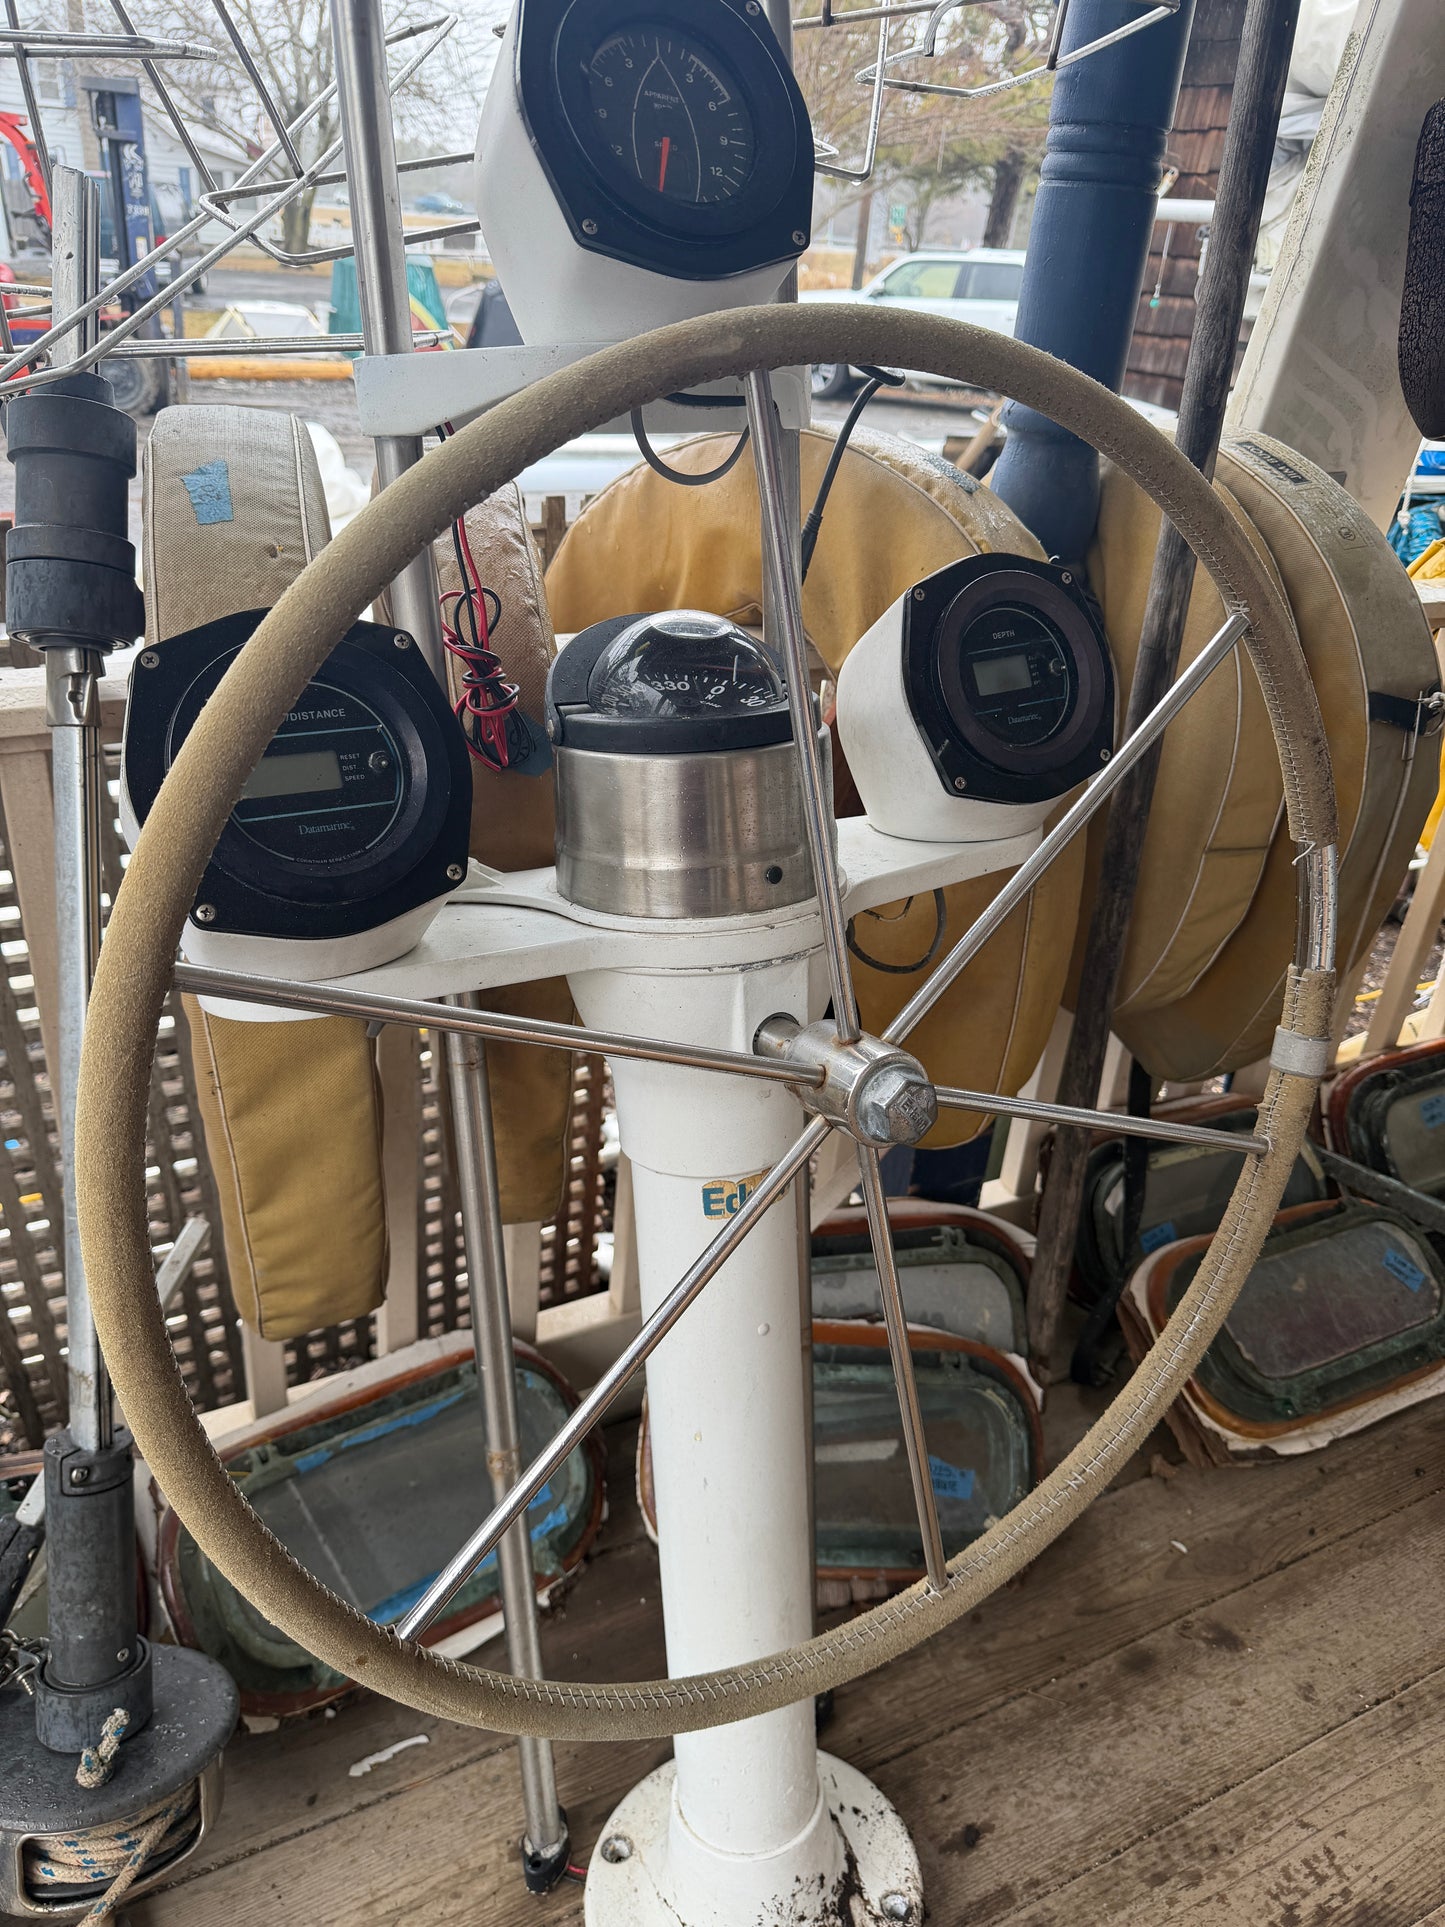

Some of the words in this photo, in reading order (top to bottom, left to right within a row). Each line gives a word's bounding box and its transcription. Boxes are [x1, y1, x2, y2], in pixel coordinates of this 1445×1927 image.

[624, 58, 633, 69] 3
[604, 76, 614, 87] 6
[685, 73, 695, 83] 3
[708, 101, 717, 112] 6
[598, 108, 608, 119] 9
[719, 135, 728, 146] 9
[710, 166, 724, 177] 12
[992, 629, 1015, 640] DEPTH
[651, 681, 690, 692] 330
[710, 685, 725, 695] 0
[740, 695, 766, 707] 30
[339, 753, 360, 761] RESET
[344, 774, 365, 782] SPEED
[298, 822, 351, 835] Datamarine
